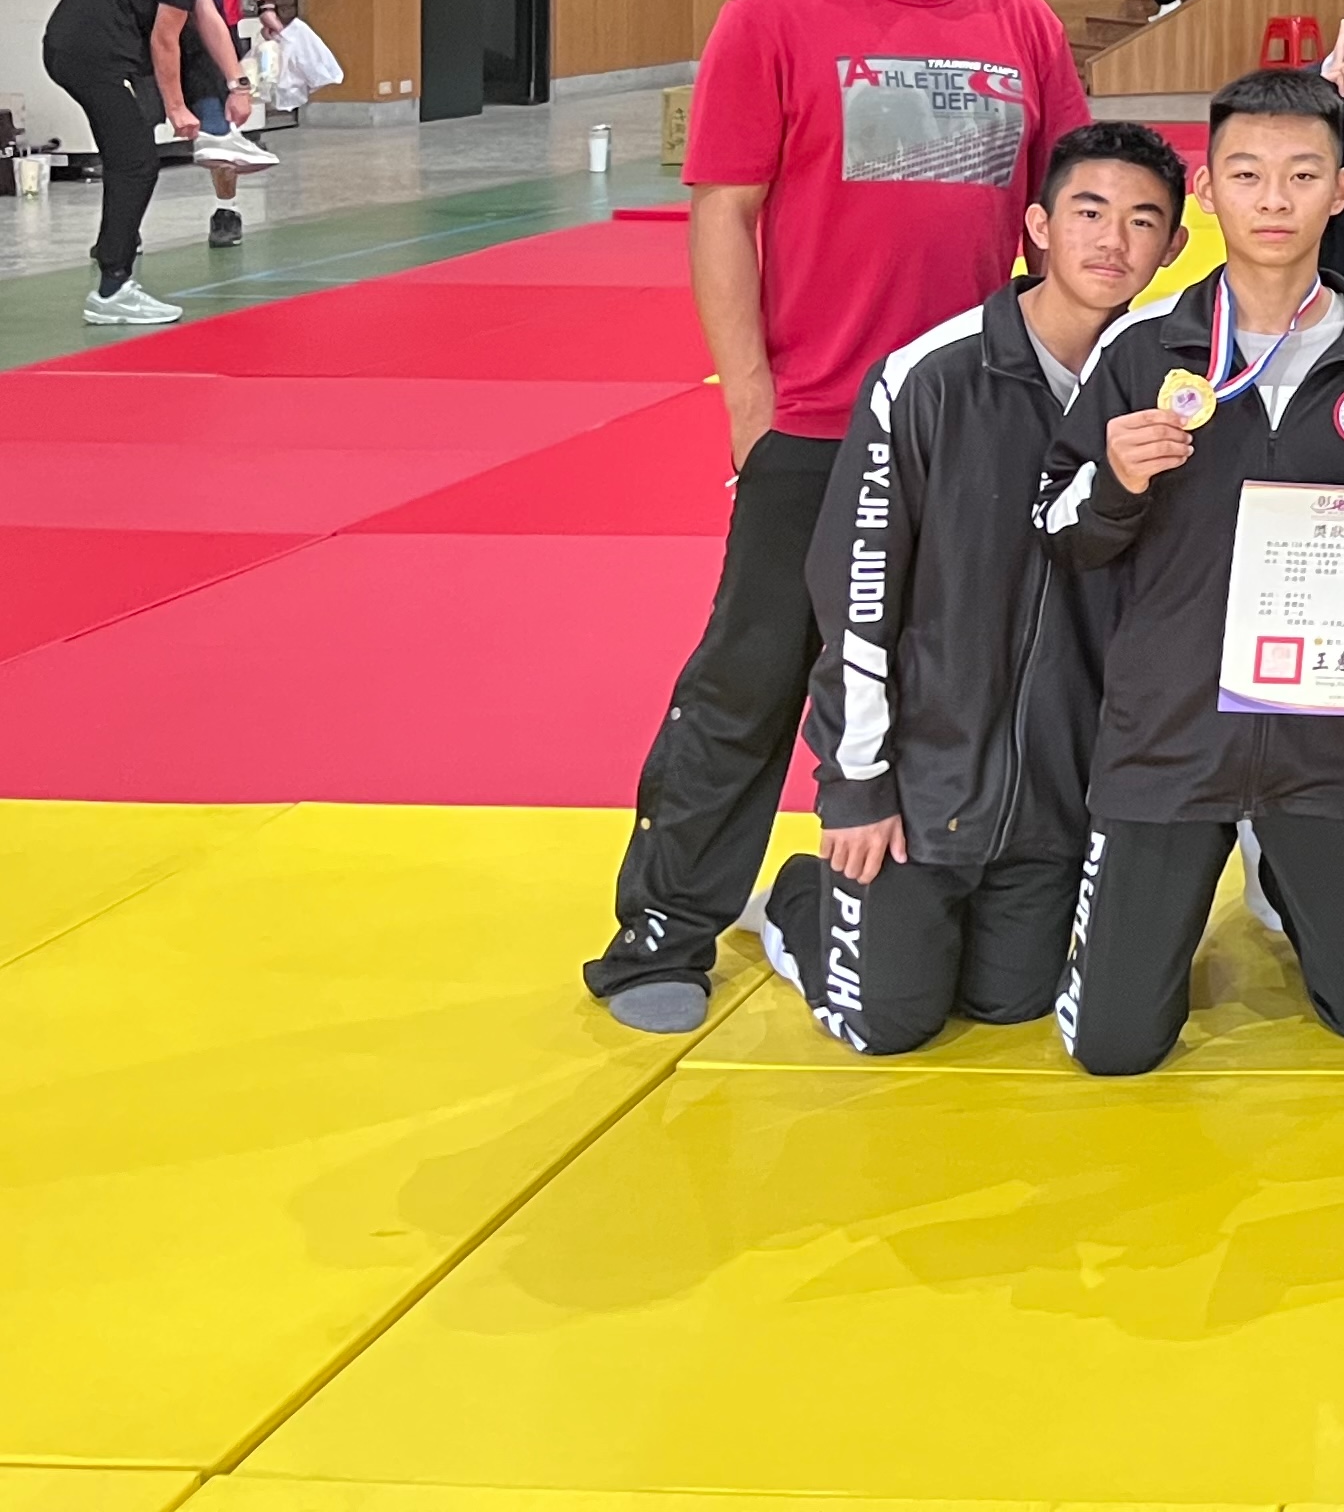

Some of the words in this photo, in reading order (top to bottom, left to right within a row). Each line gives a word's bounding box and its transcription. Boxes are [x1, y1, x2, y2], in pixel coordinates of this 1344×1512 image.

[843, 58, 965, 90] ATHLETIC
[855, 443, 890, 529] PYJH
[849, 539, 887, 623] JUDO
[827, 887, 863, 1011] PYJH
